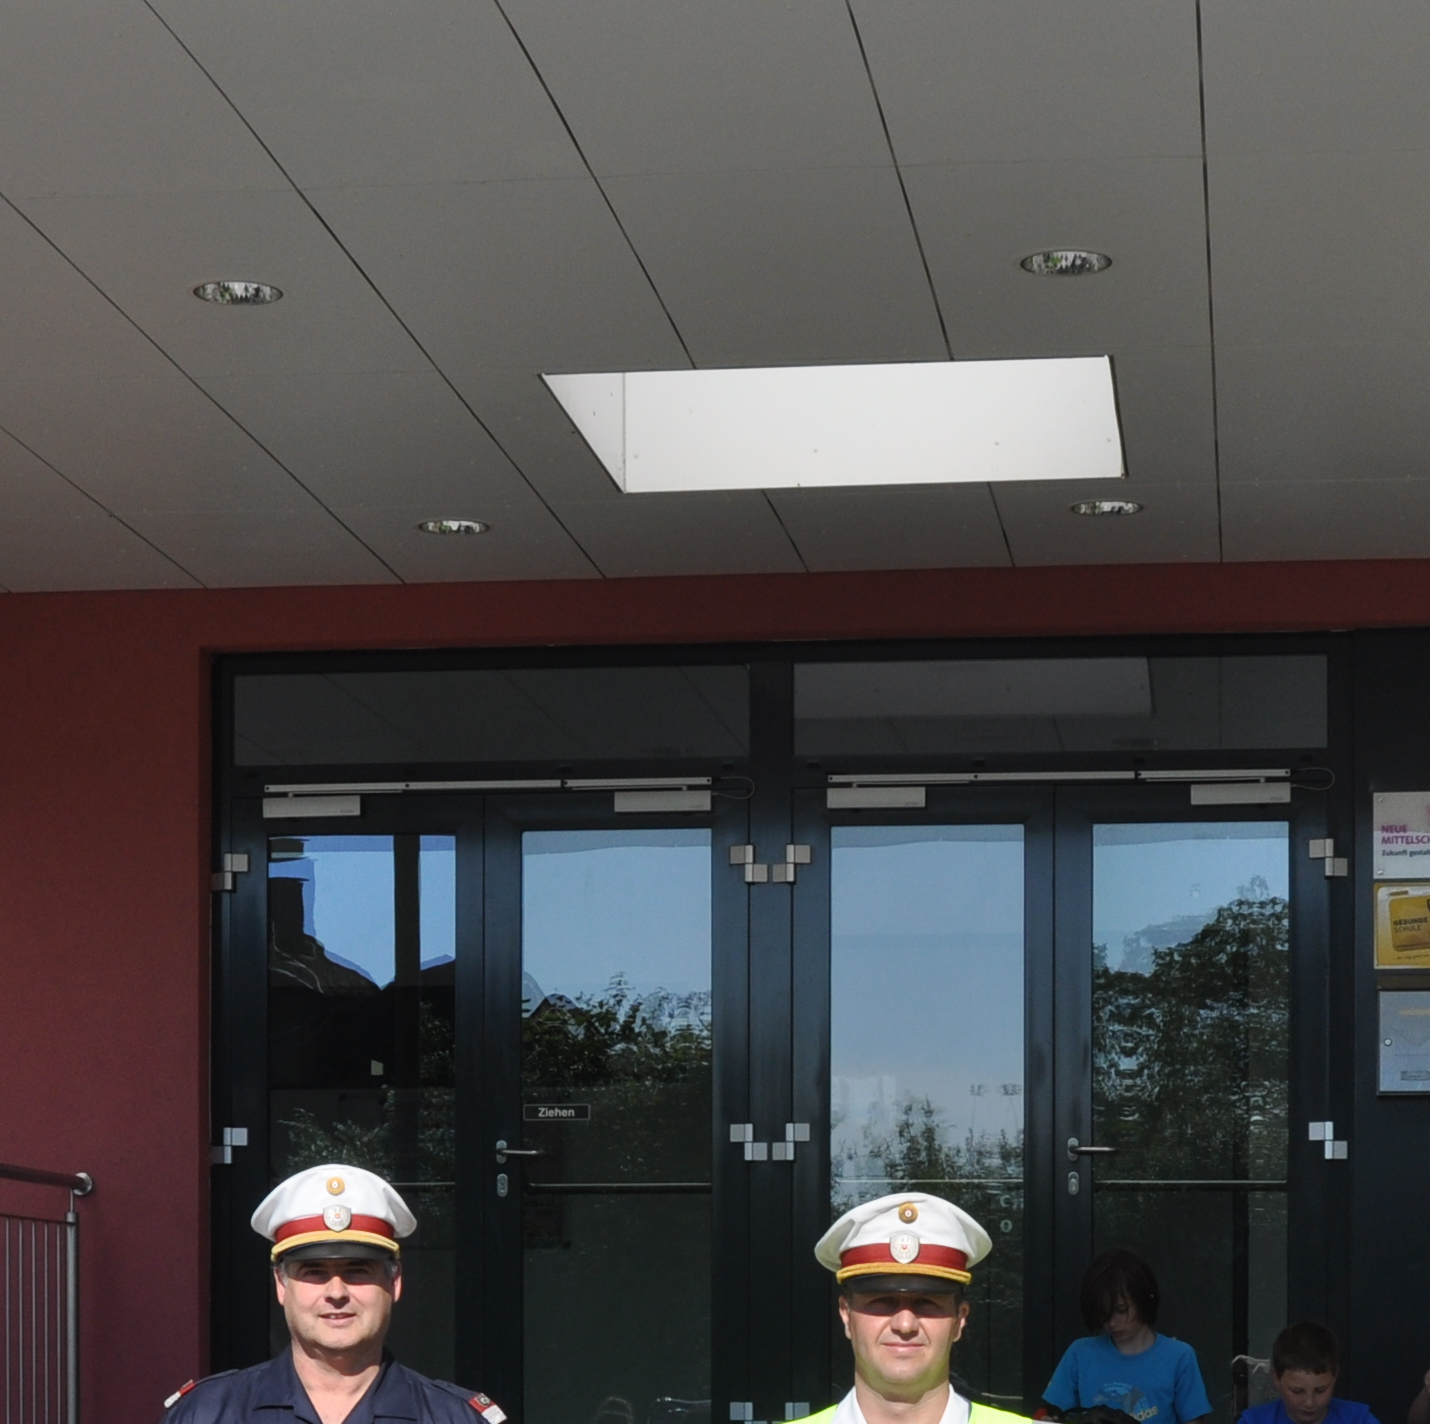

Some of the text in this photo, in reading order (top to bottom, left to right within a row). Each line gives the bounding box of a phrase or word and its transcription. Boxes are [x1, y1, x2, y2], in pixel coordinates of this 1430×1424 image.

[1381, 824, 1408, 834] NEUE
[1381, 849, 1408, 857] Zukunft
[537, 1107, 575, 1118] Ziehen
